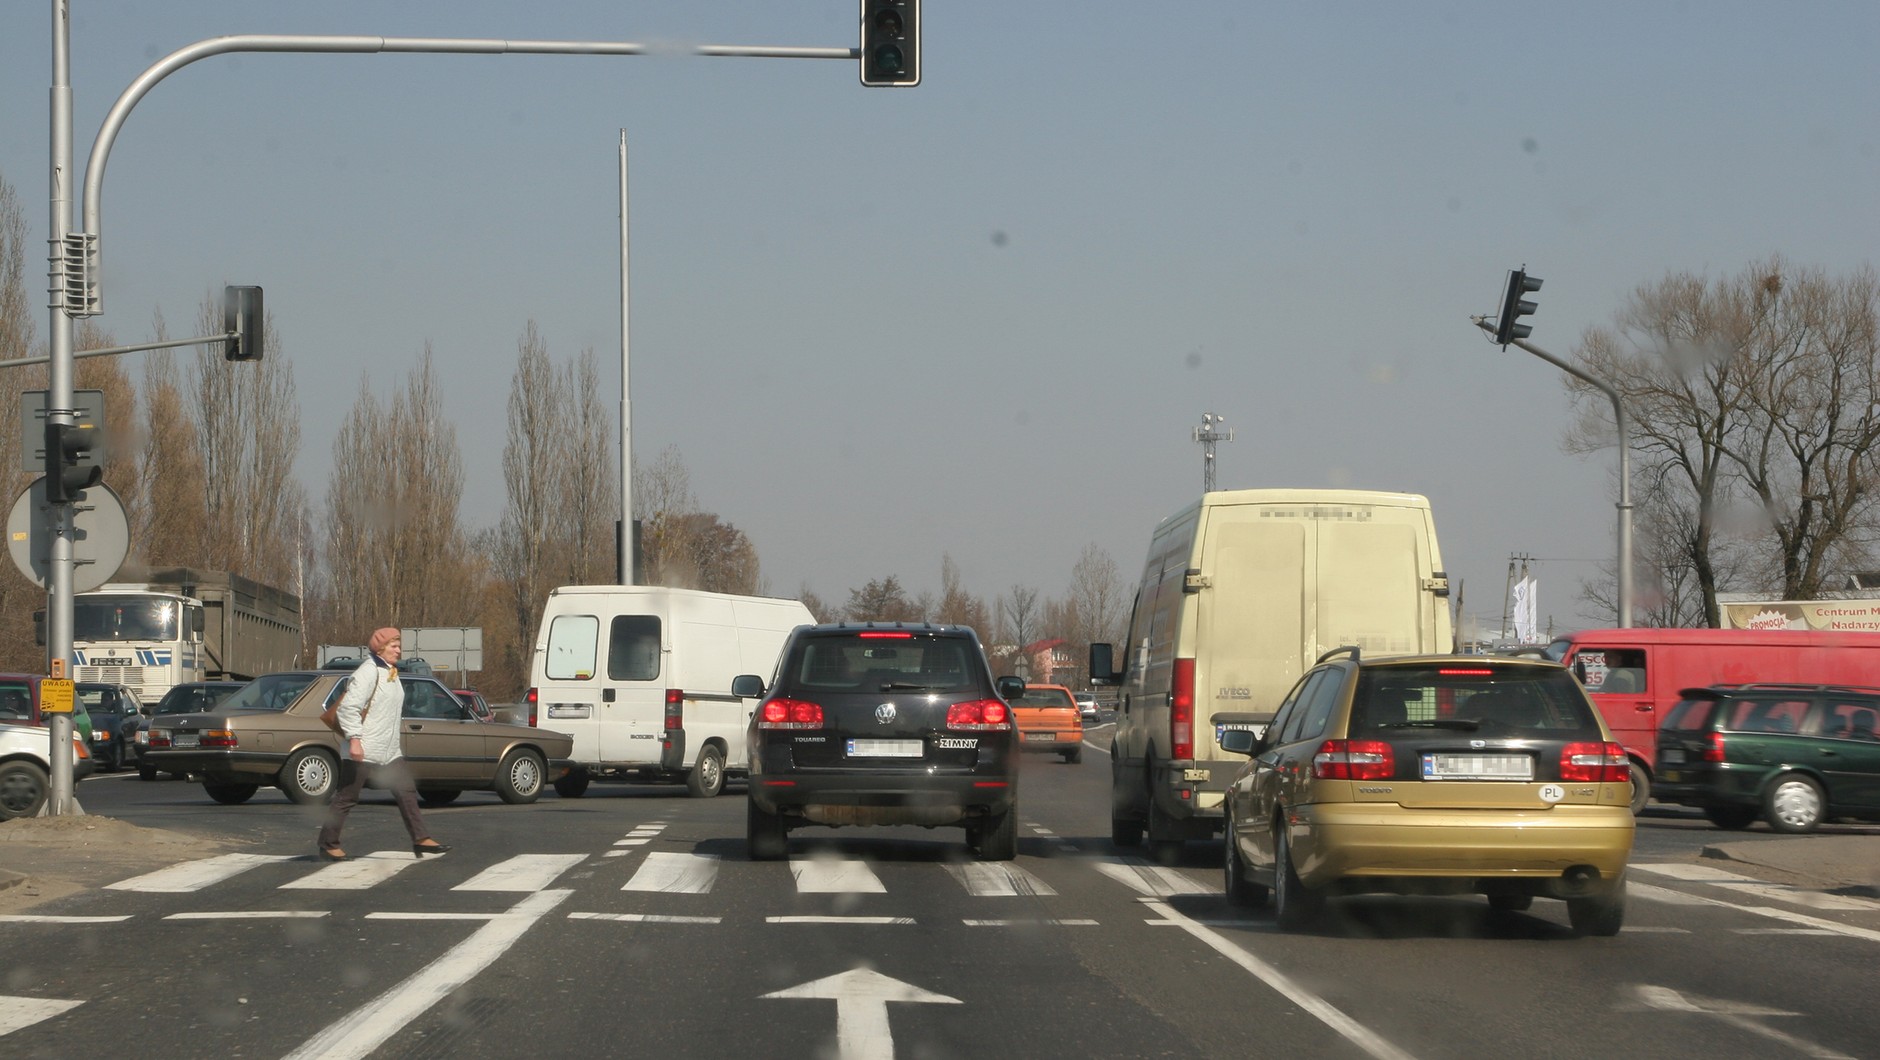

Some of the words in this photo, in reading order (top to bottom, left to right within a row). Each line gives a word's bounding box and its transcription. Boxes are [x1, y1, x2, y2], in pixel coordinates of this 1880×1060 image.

[1816, 608, 1867, 617] Centrum
[1750, 617, 1786, 630] PROMOCJA
[42, 680, 73, 688] UWAGA!
[1219, 687, 1251, 696] IVECO
[940, 738, 978, 748] ZIMNY
[1359, 786, 1393, 794] VOLVO
[1545, 788, 1559, 798] PL
